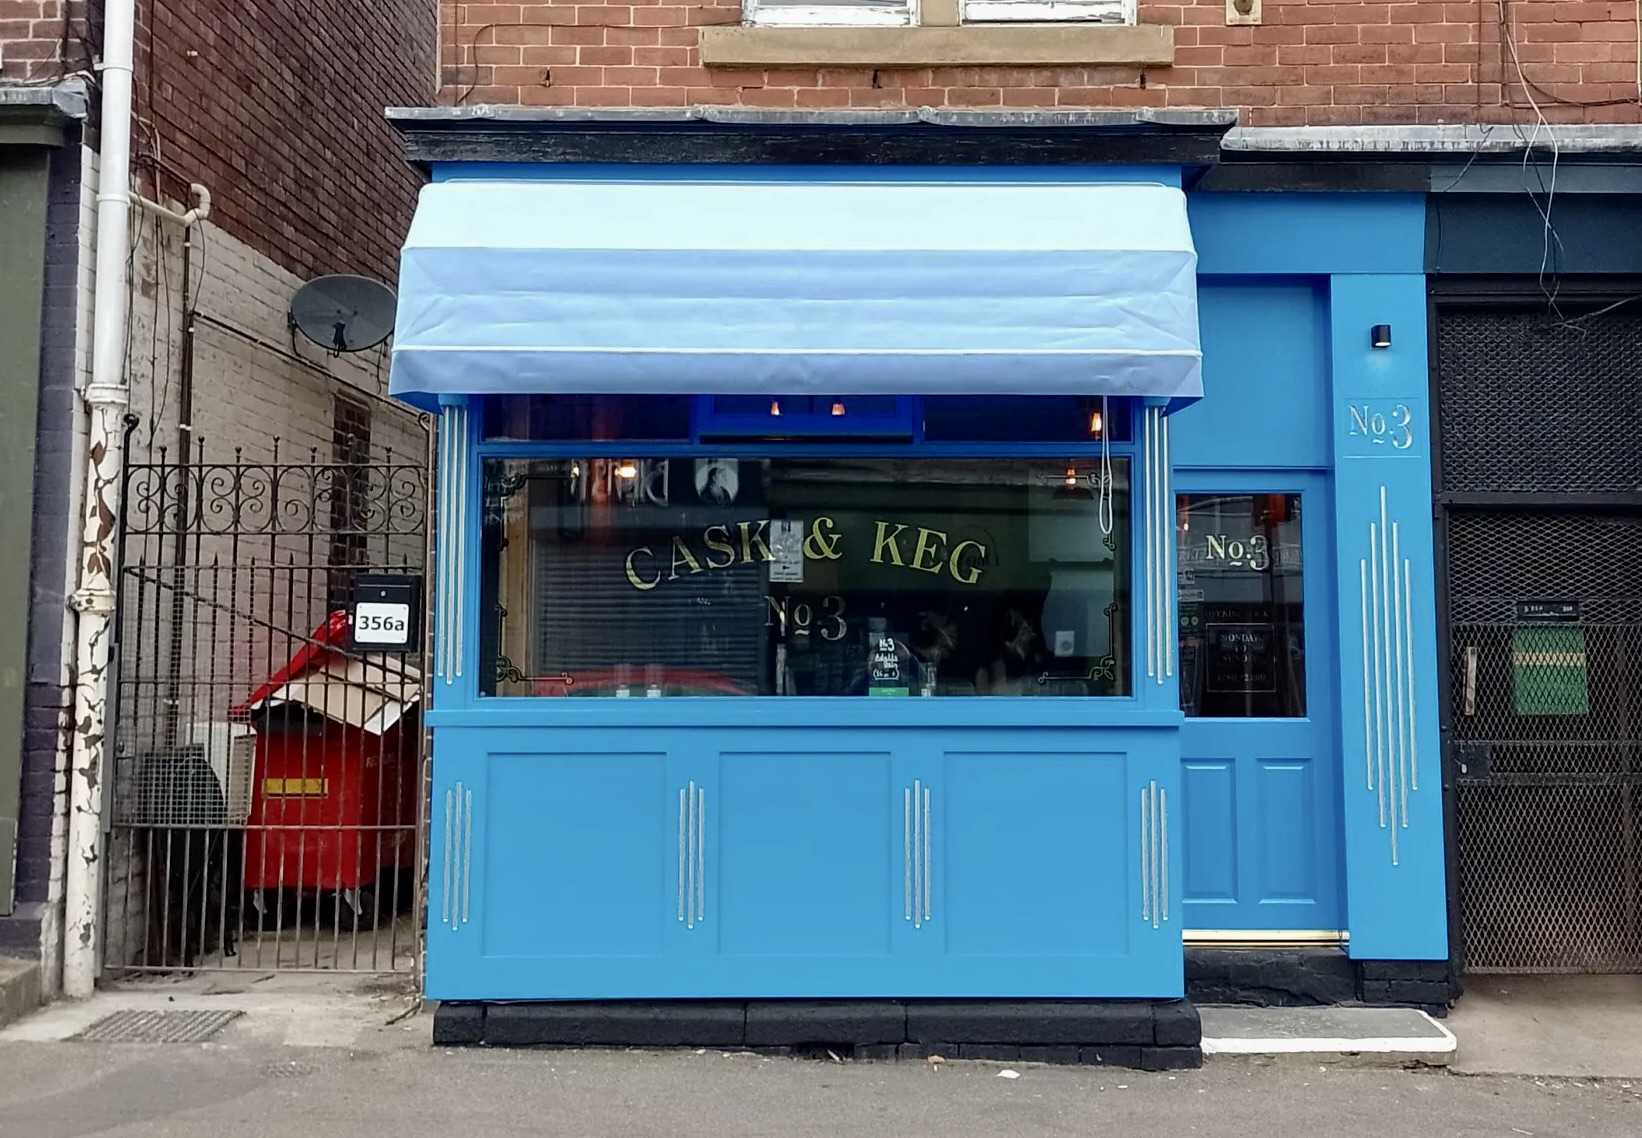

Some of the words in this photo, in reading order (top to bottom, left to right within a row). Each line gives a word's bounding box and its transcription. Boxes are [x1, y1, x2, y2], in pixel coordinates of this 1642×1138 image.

[624, 519, 776, 591] CASK
[803, 516, 843, 560] &
[869, 520, 987, 584] KEG
[358, 615, 405, 631] 356a
